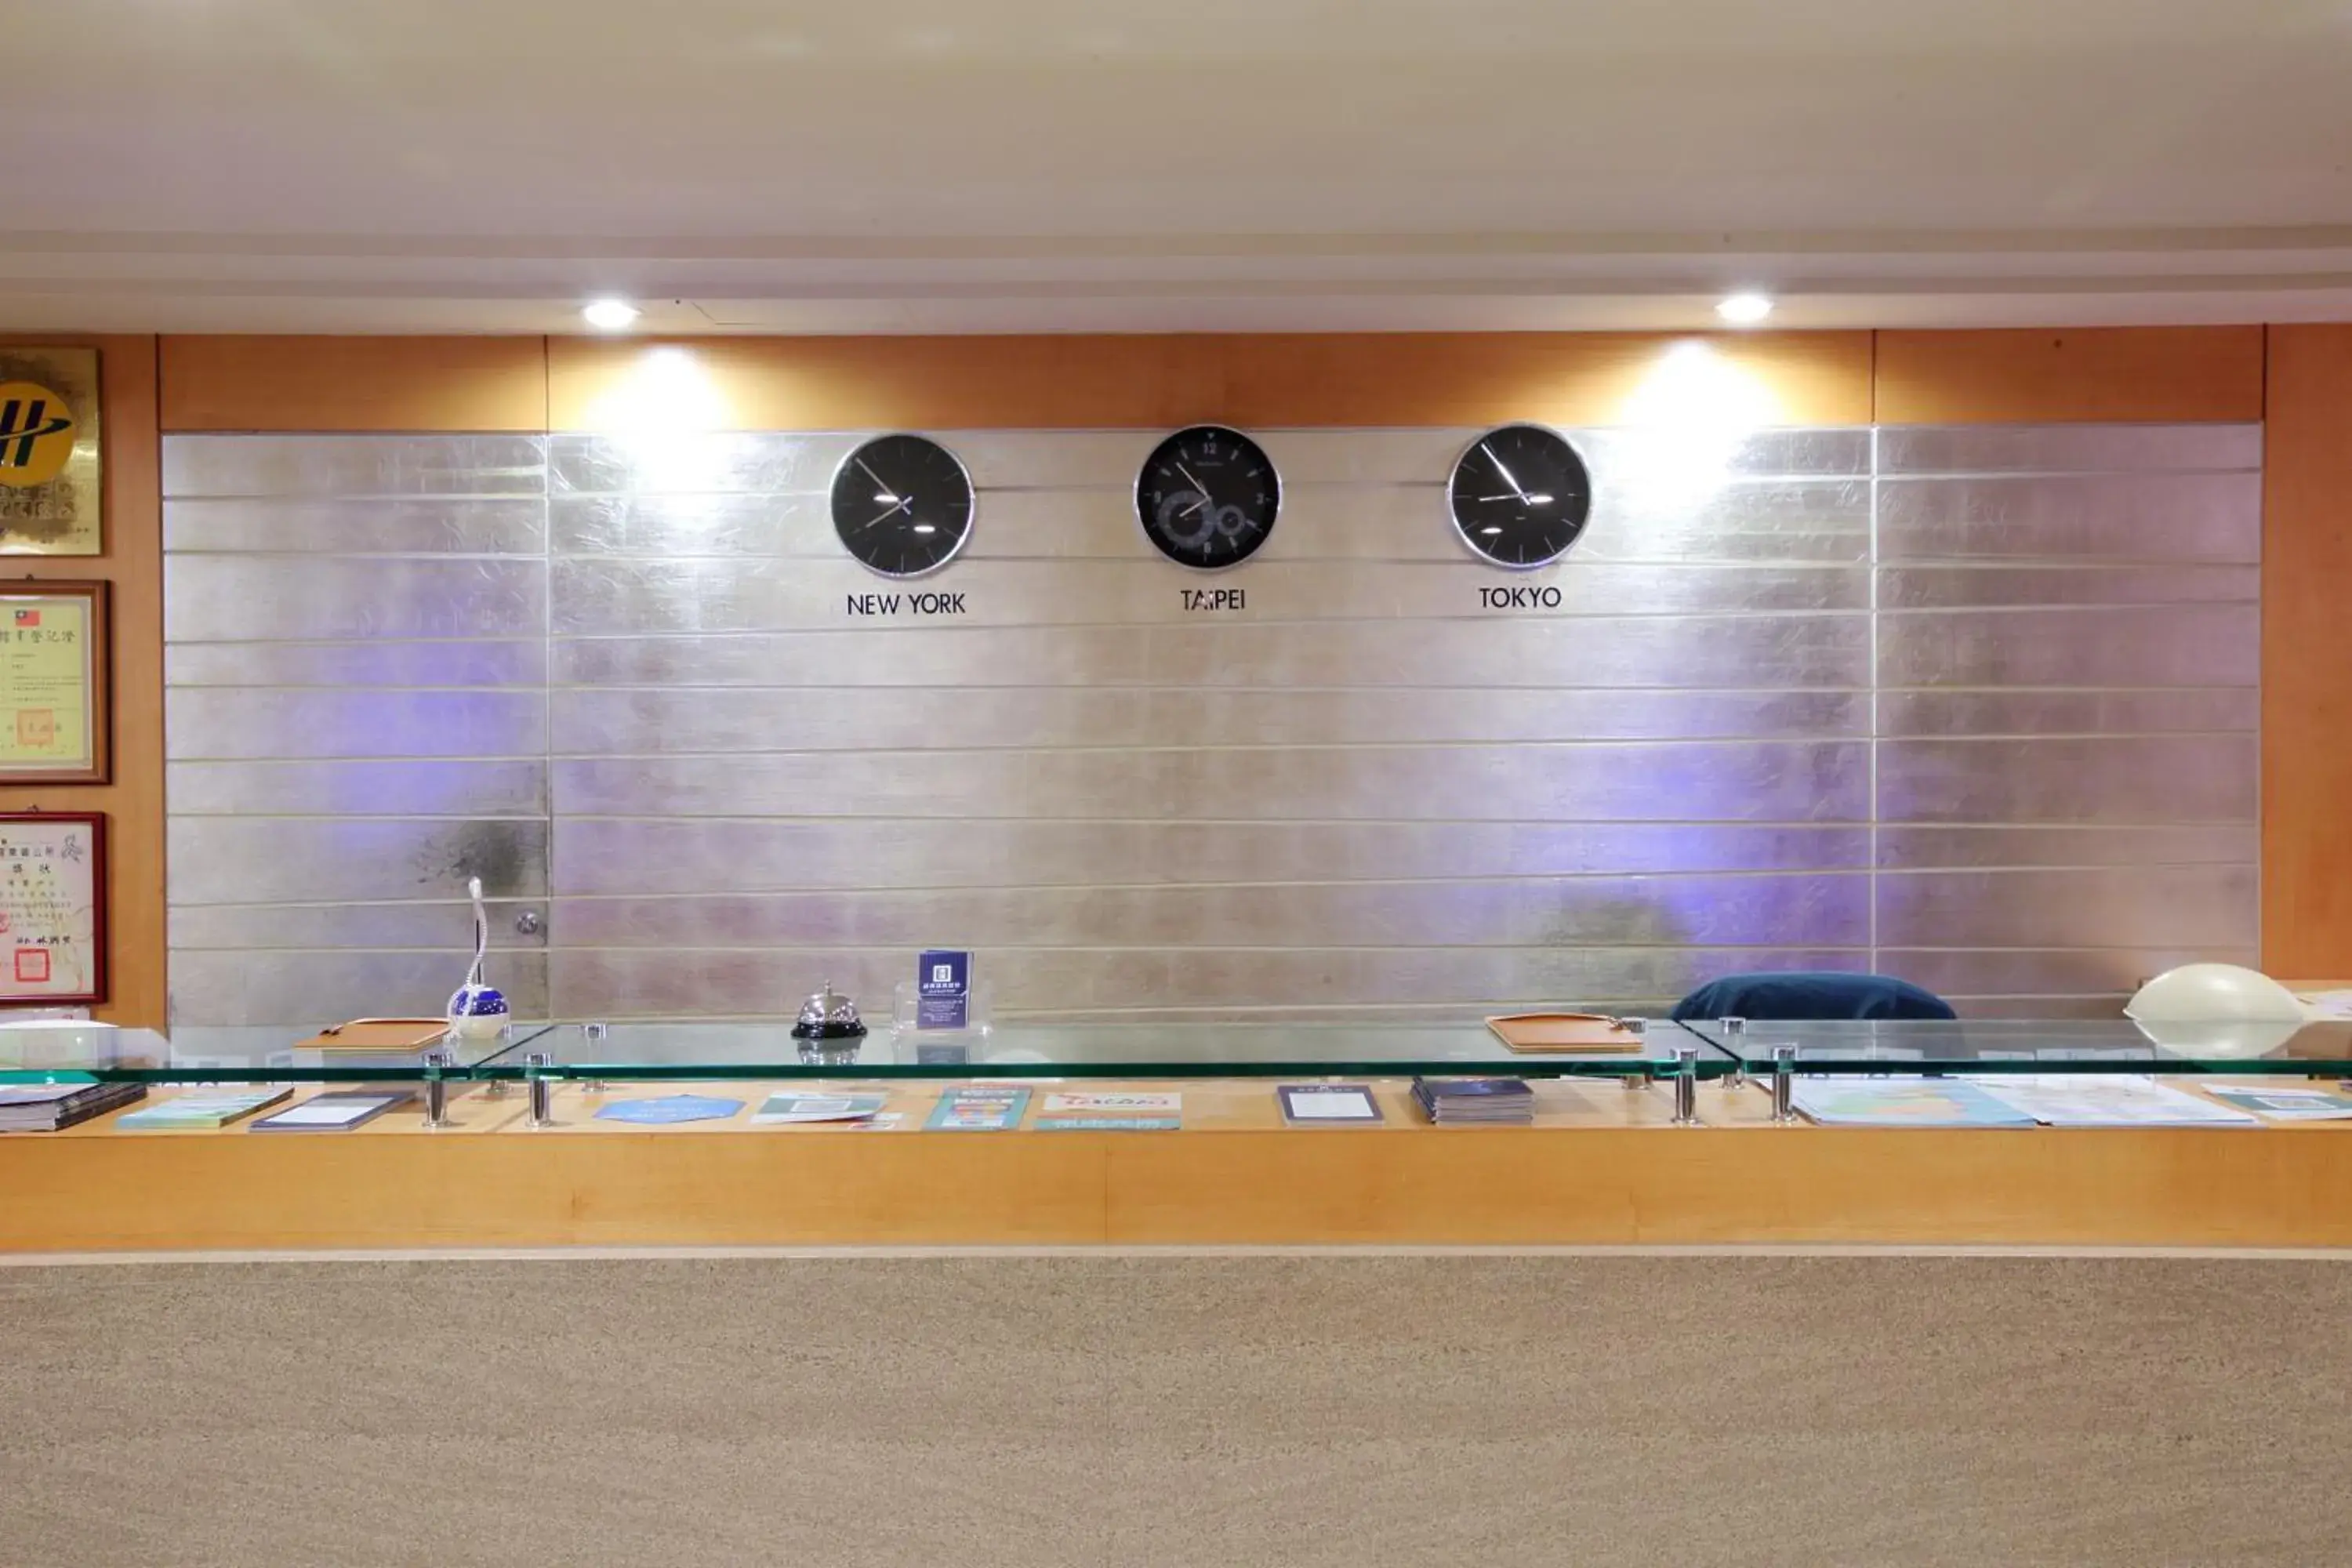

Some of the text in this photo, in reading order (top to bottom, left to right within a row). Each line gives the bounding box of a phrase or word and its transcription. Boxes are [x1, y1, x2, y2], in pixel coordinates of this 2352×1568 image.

[848, 593, 966, 615] NEW YORK
[1181, 590, 1245, 611] TAIPEI
[1479, 587, 1562, 608] TOKYO
